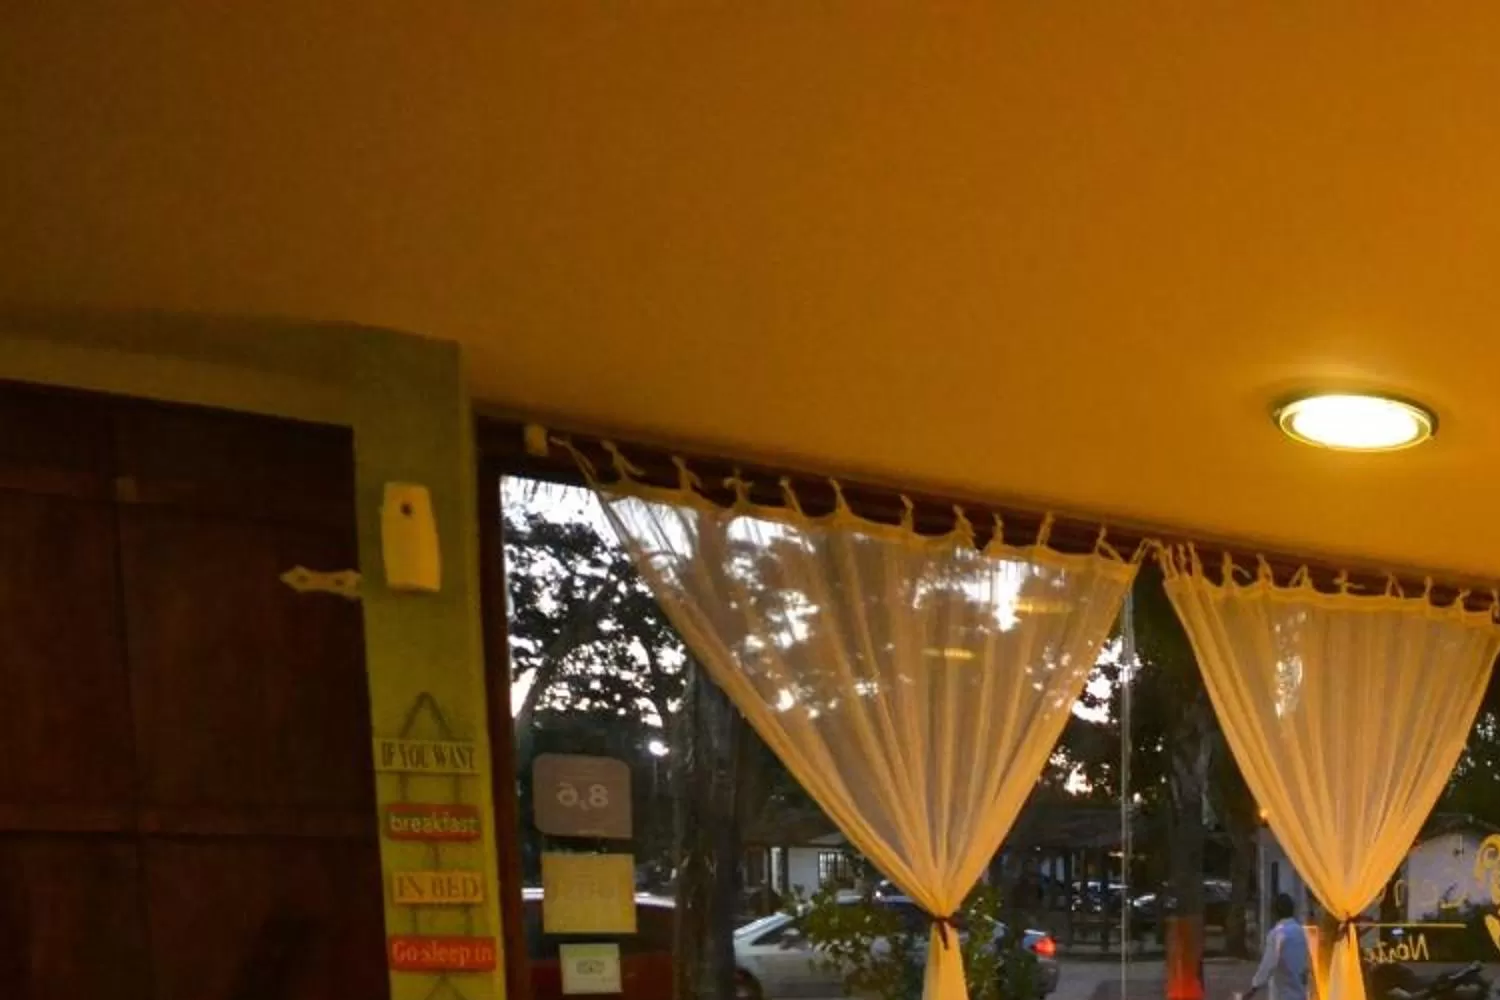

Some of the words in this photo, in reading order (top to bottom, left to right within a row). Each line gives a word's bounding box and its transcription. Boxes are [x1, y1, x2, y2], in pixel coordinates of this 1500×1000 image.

[390, 811, 479, 833] breakfast
[397, 875, 425, 898] IN
[431, 875, 479, 899] BED
